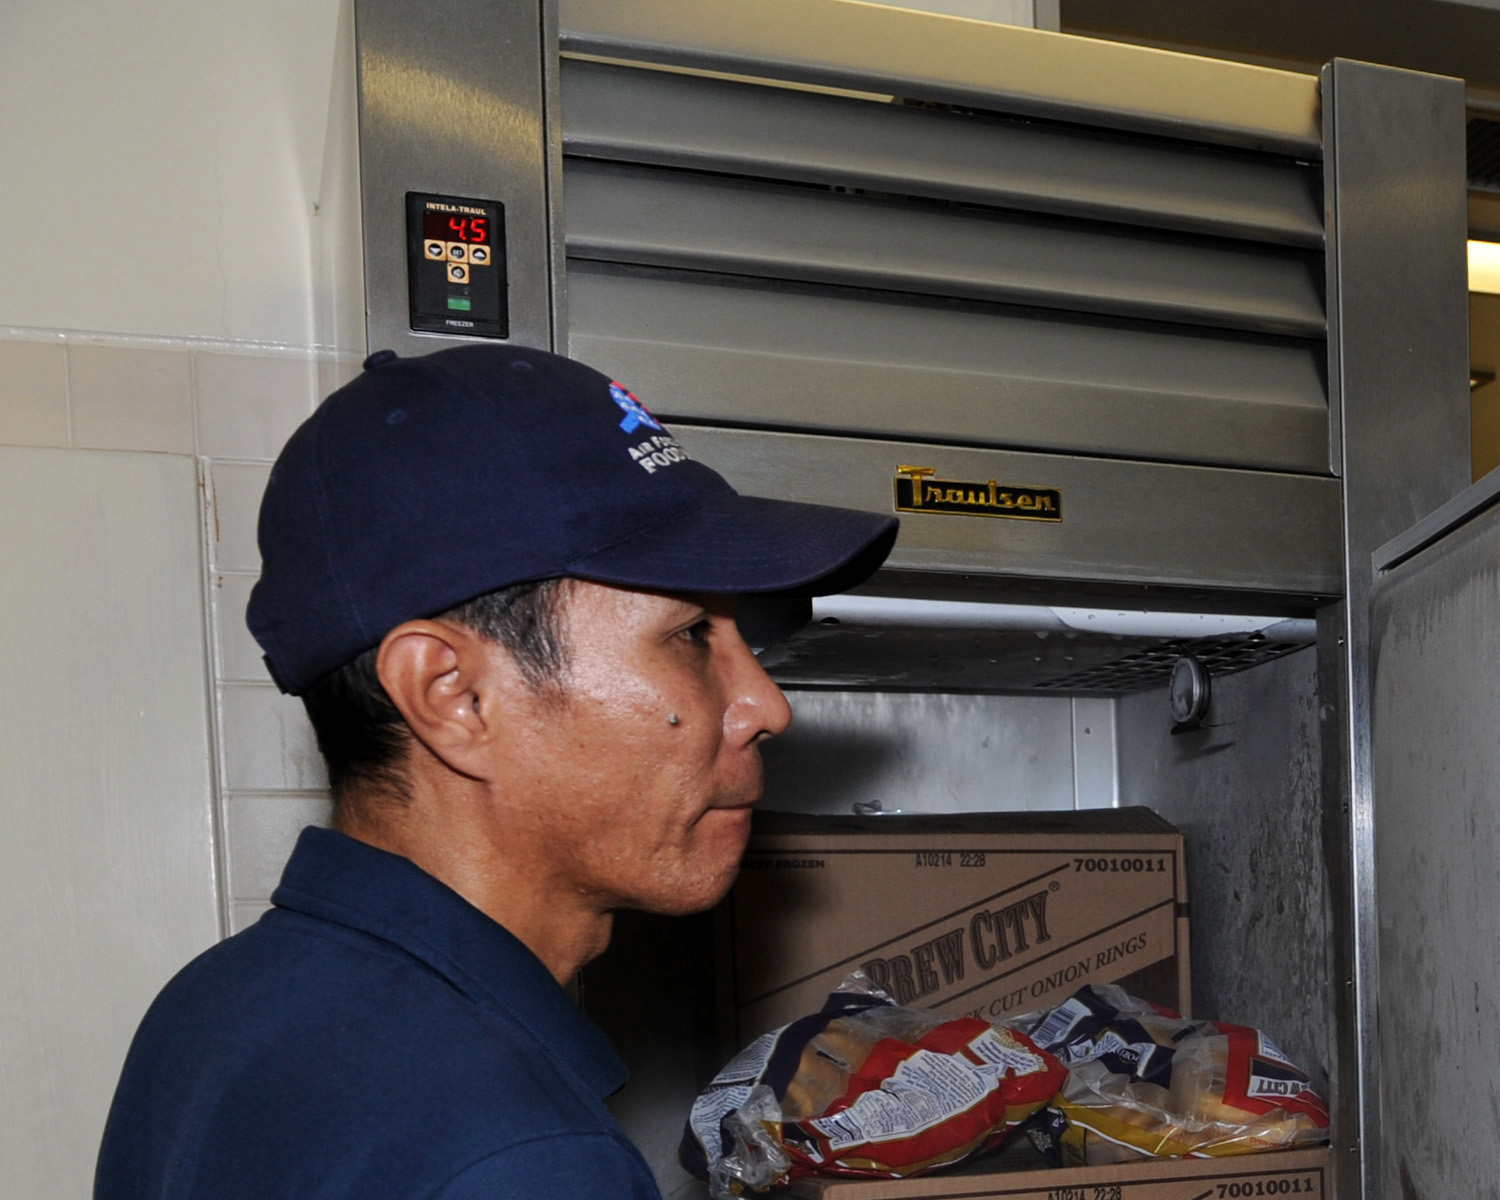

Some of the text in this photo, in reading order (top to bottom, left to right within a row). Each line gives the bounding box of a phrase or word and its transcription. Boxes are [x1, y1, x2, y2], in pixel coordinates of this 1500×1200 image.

[426, 202, 486, 215] INTELA-TRAUL
[446, 319, 474, 328] FREEZER
[627, 441, 656, 461] AIR
[896, 464, 1057, 512] Traulsen
[775, 859, 825, 869] FROZEN
[915, 852, 952, 869] A10214
[1073, 858, 1166, 873] 70010011
[861, 928, 965, 1006] BREW
[988, 932, 1148, 1017] CUT ONION RINGS
[1216, 1178, 1314, 1200] 70010011
